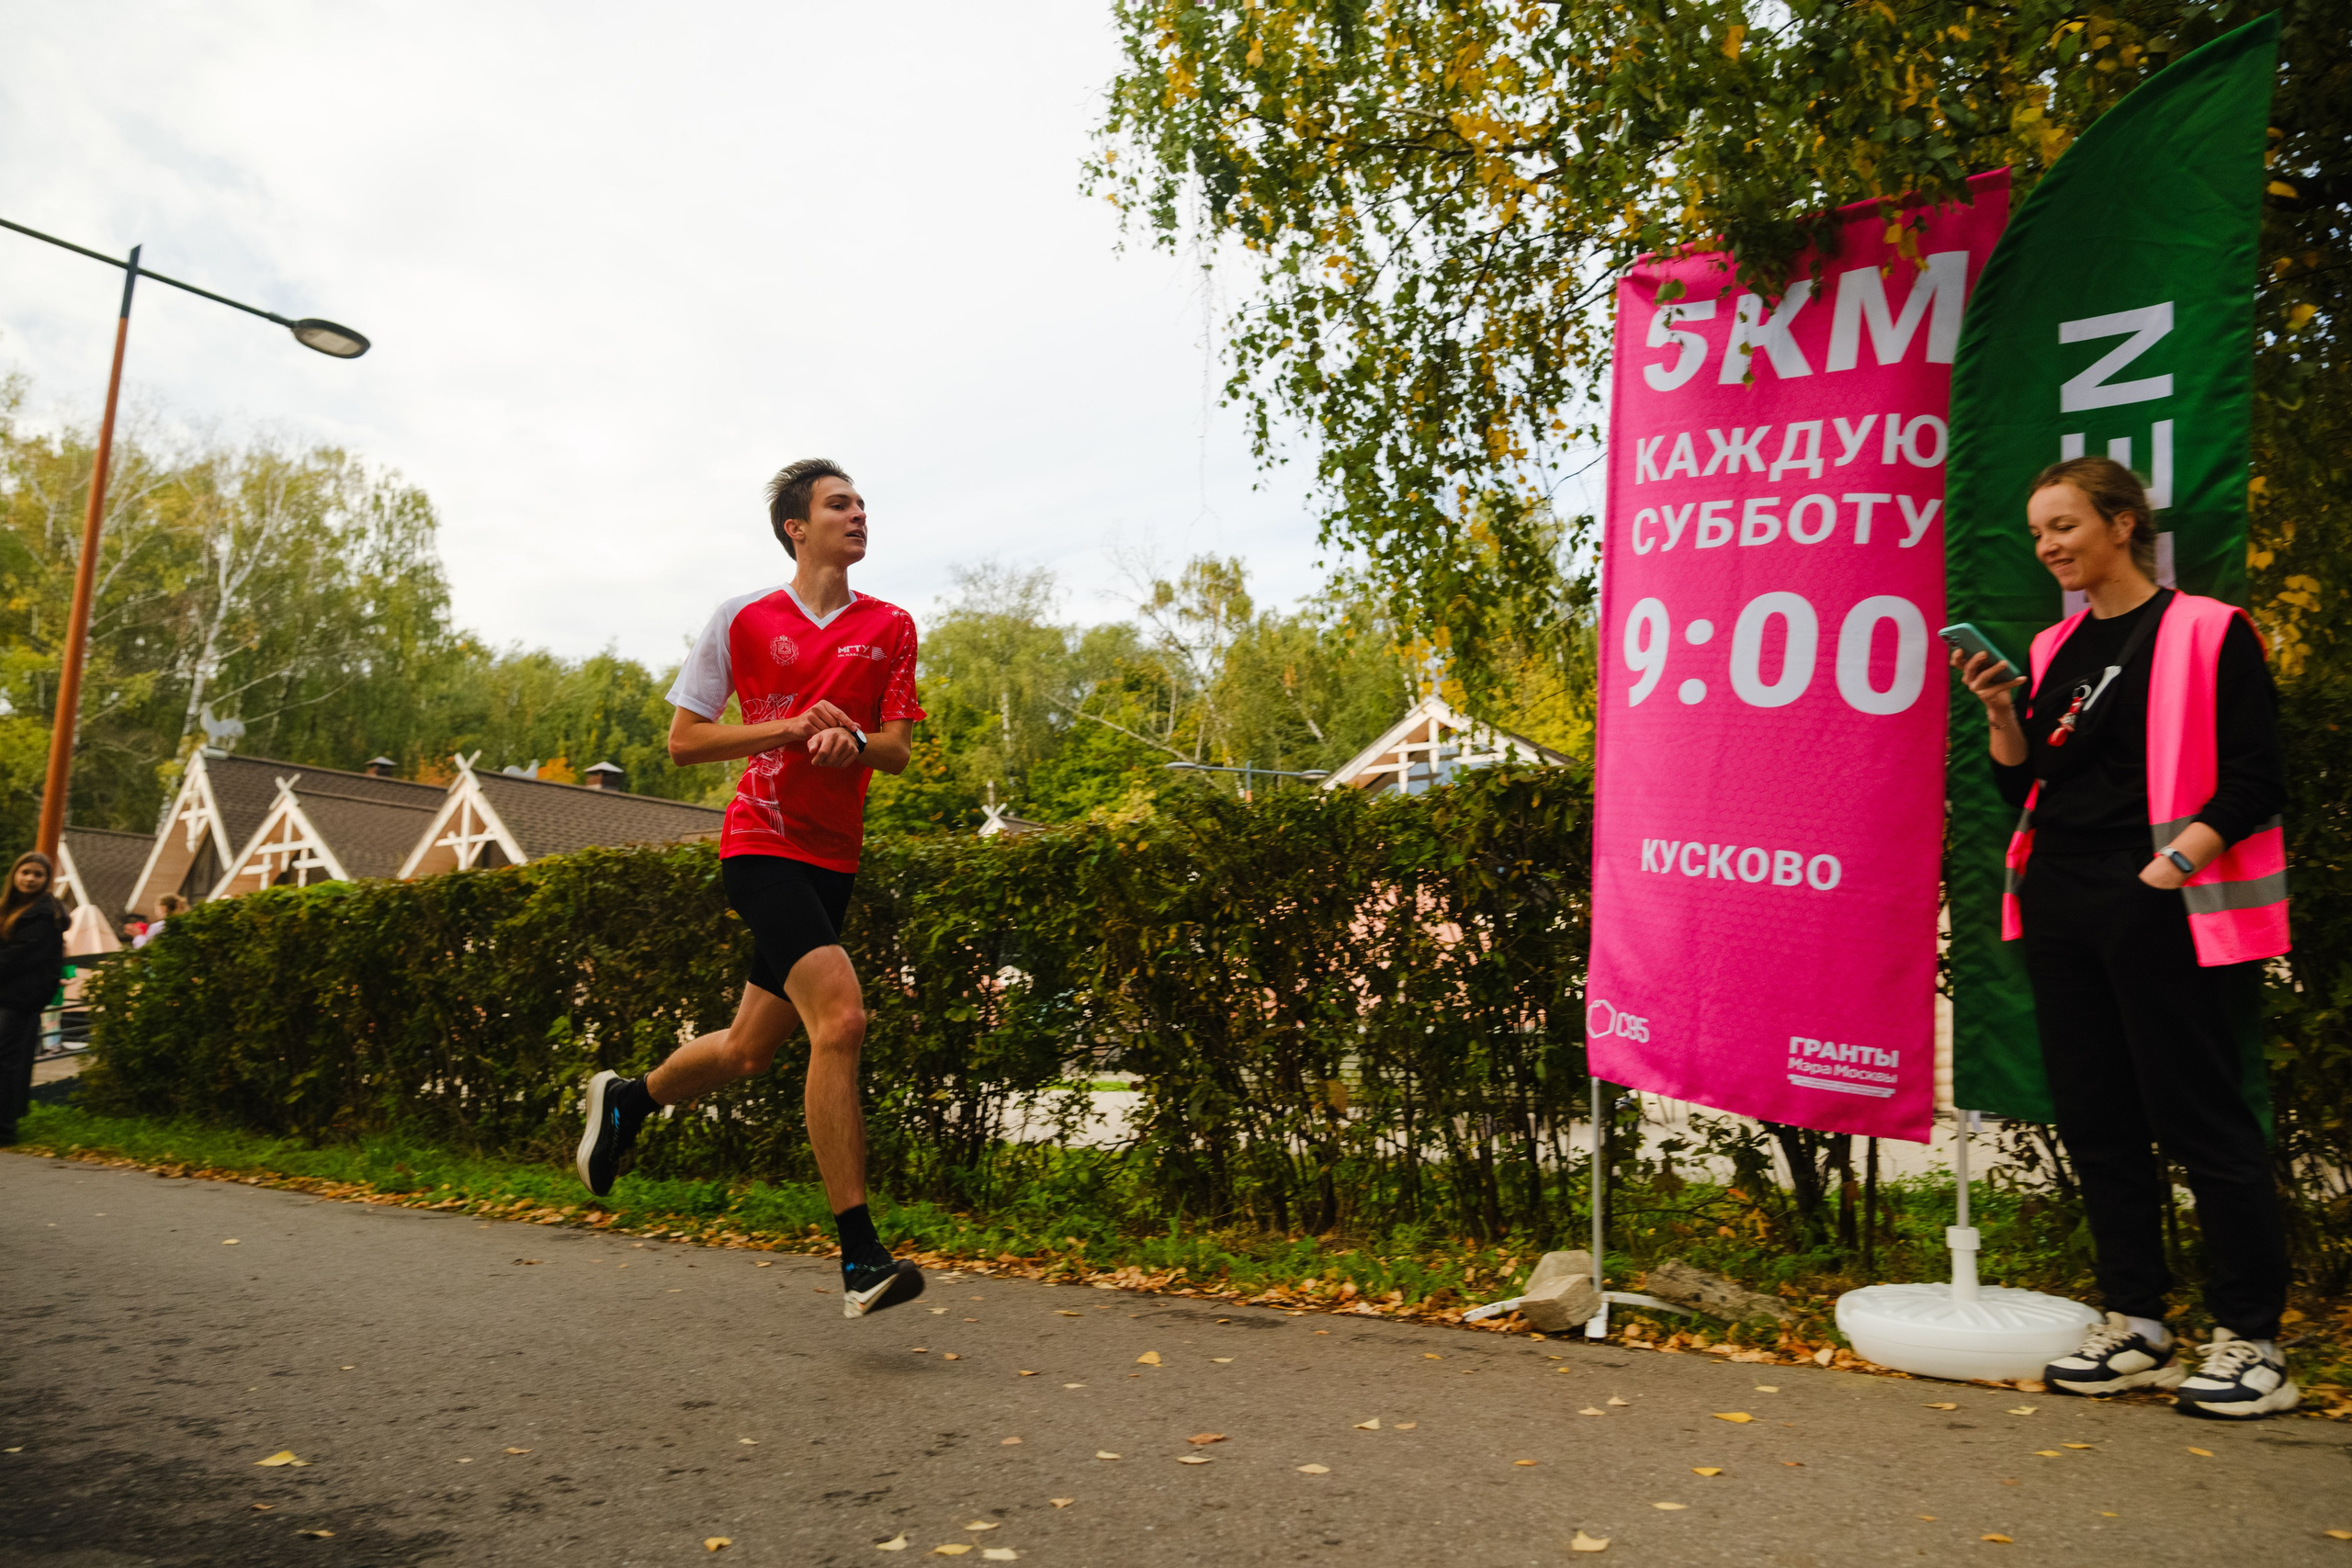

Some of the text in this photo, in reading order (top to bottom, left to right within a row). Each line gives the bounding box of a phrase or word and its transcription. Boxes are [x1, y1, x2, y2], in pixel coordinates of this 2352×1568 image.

[1635, 412, 1949, 485] КАЖДУЮ
[1632, 492, 1943, 556] СУББОТУ
[1623, 591, 1929, 716] 9:00
[1641, 838, 1841, 891] КУСКОВО
[1787, 1056, 1898, 1084] Мэра Москвы
[1789, 1036, 1900, 1067] ГРАНТЫ
